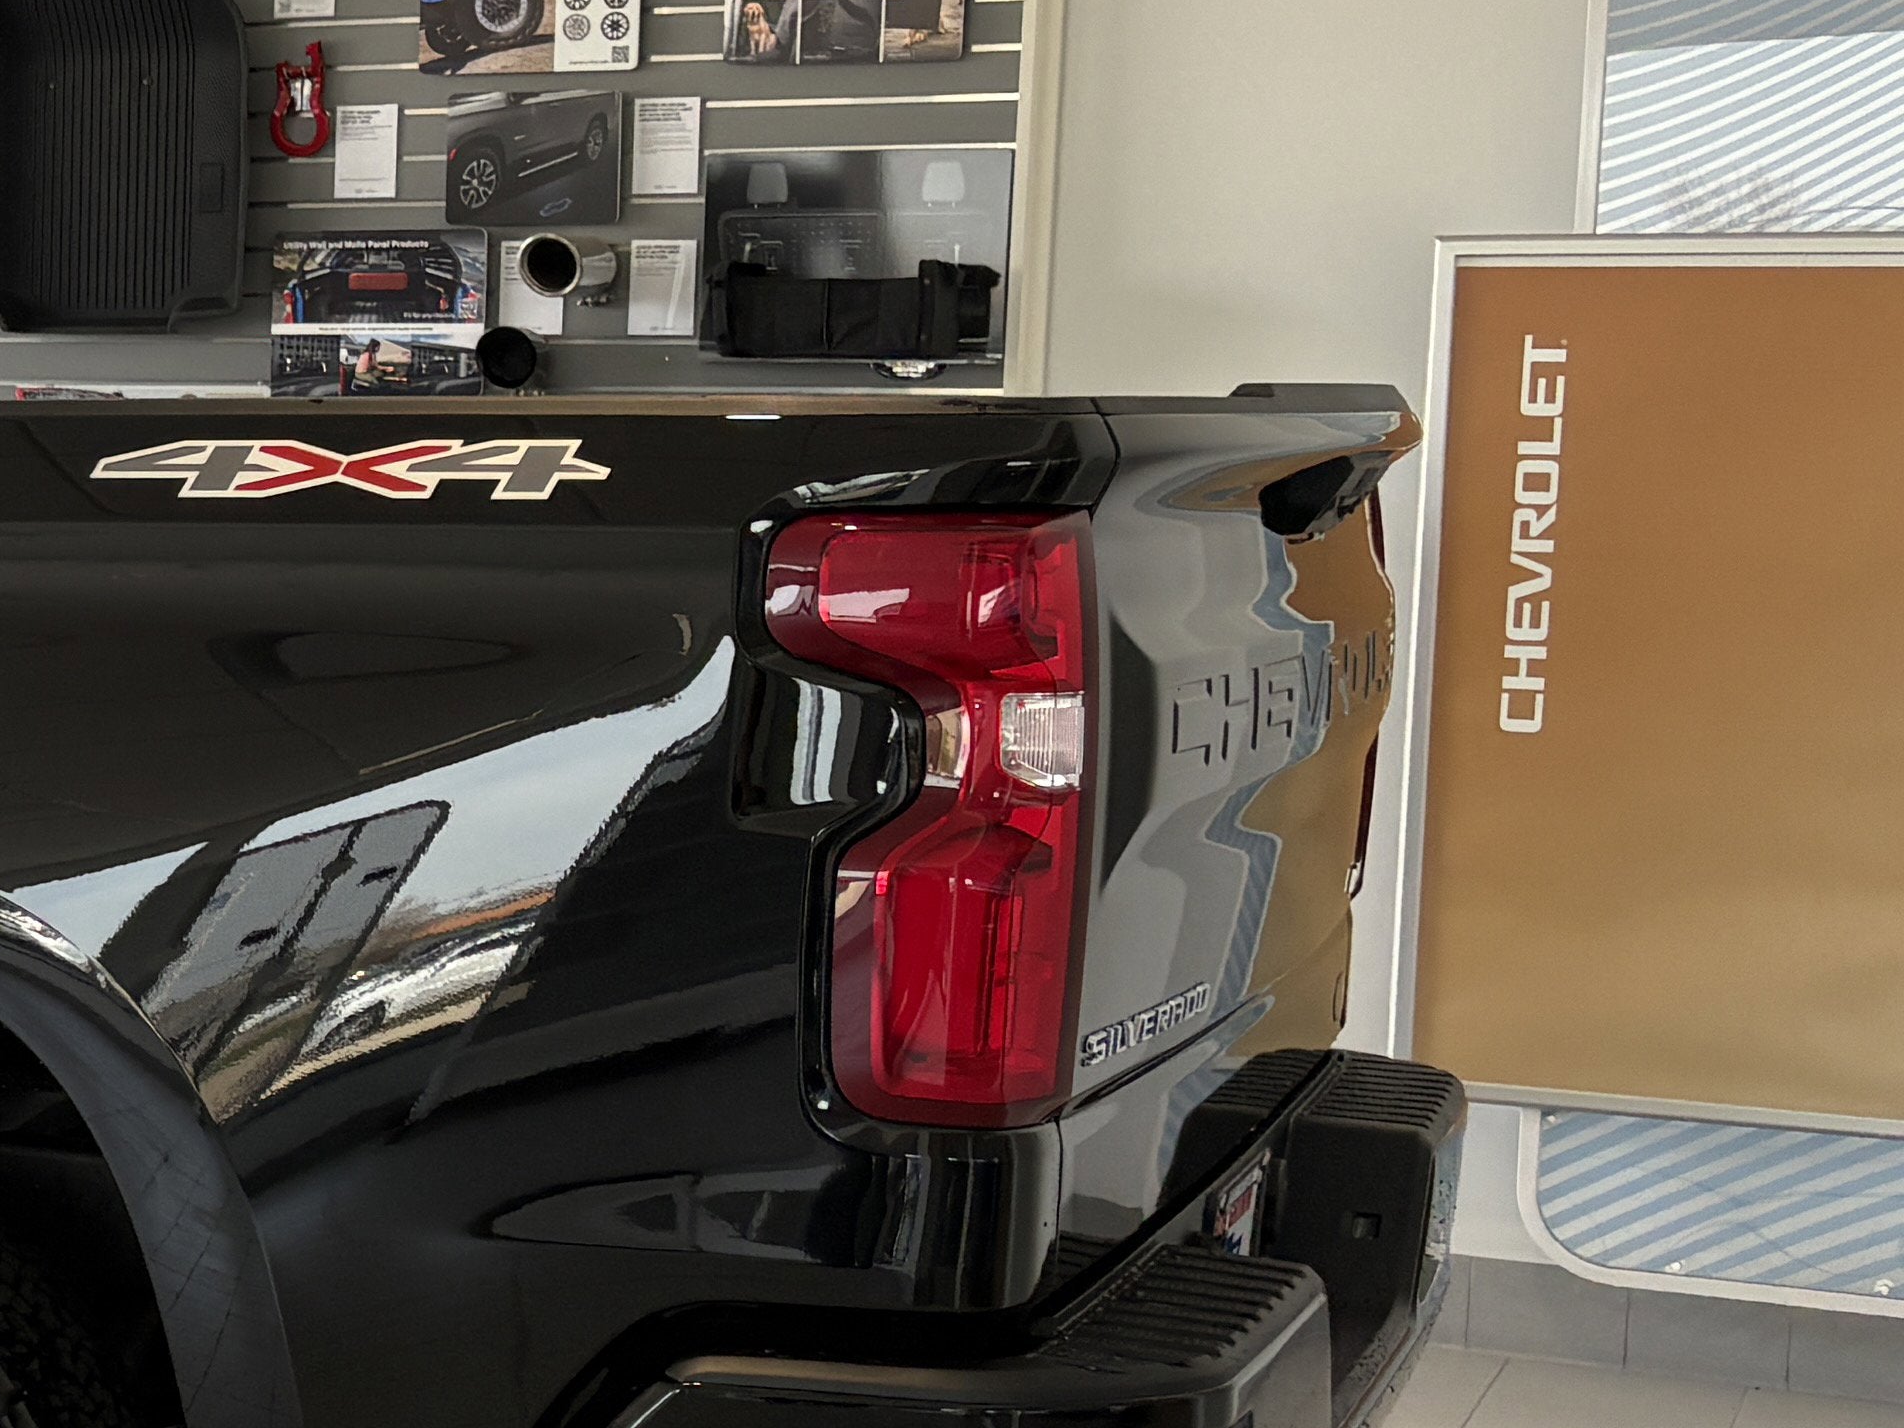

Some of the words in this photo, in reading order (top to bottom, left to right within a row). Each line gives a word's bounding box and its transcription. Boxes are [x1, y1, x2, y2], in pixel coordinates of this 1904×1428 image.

[328, 241, 343, 249] and
[391, 239, 429, 248] Products
[1499, 334, 1567, 733] CHEVROLET
[1081, 981, 1211, 1067] SILVERADO
